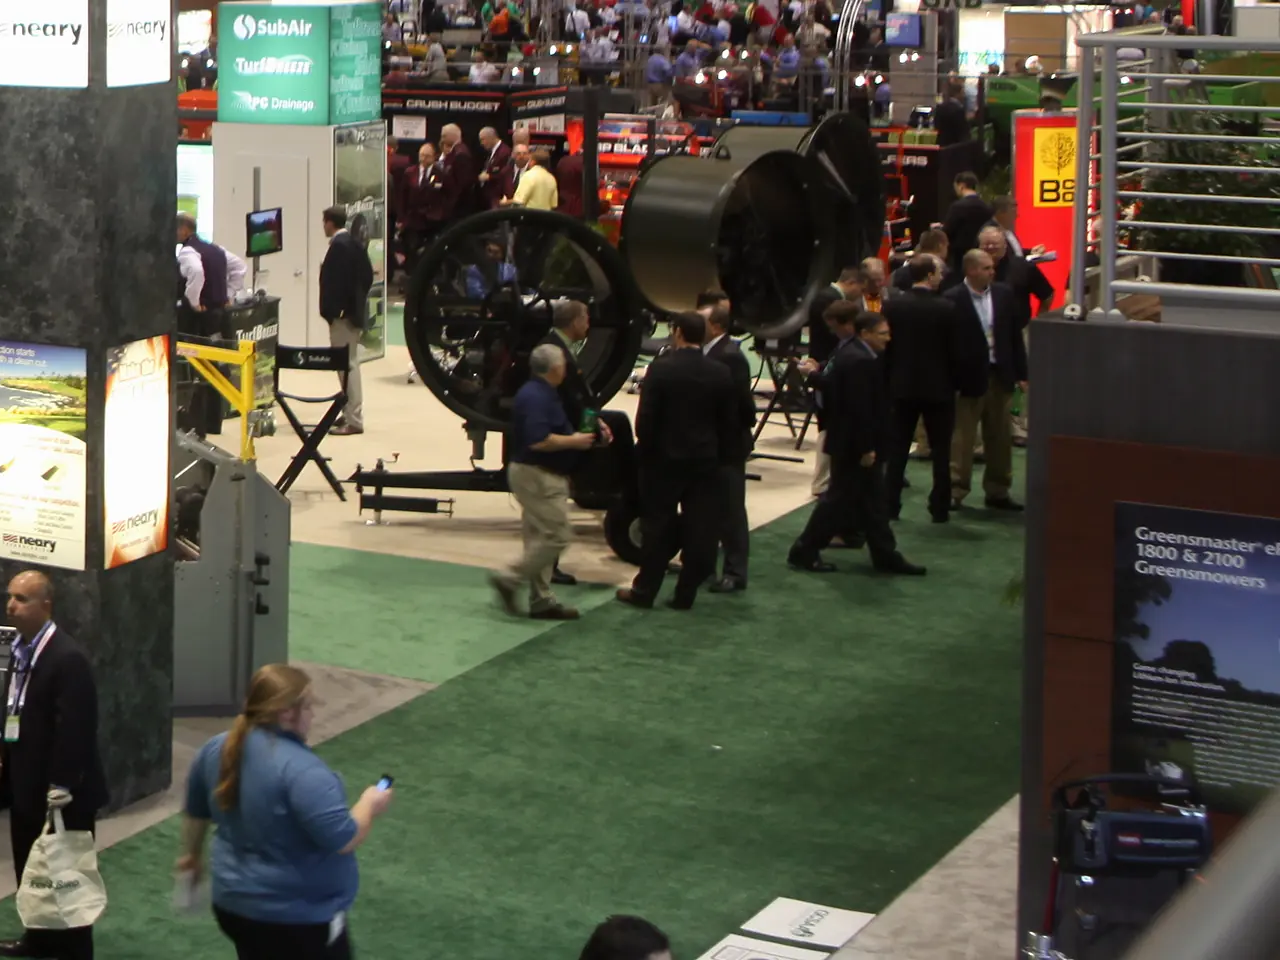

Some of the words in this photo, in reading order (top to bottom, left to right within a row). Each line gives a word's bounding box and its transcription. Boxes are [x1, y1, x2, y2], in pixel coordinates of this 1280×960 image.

[12, 22, 82, 45] neary
[127, 20, 166, 41] neary
[257, 19, 312, 37] SubAir
[450, 101, 500, 112] BUDGET
[127, 508, 159, 531] neary
[19, 535, 57, 553] neary
[1136, 543, 1178, 560] 1800
[1183, 549, 1198, 563] &
[1202, 551, 1246, 568] 2100
[1134, 560, 1266, 588] Greensmowers
